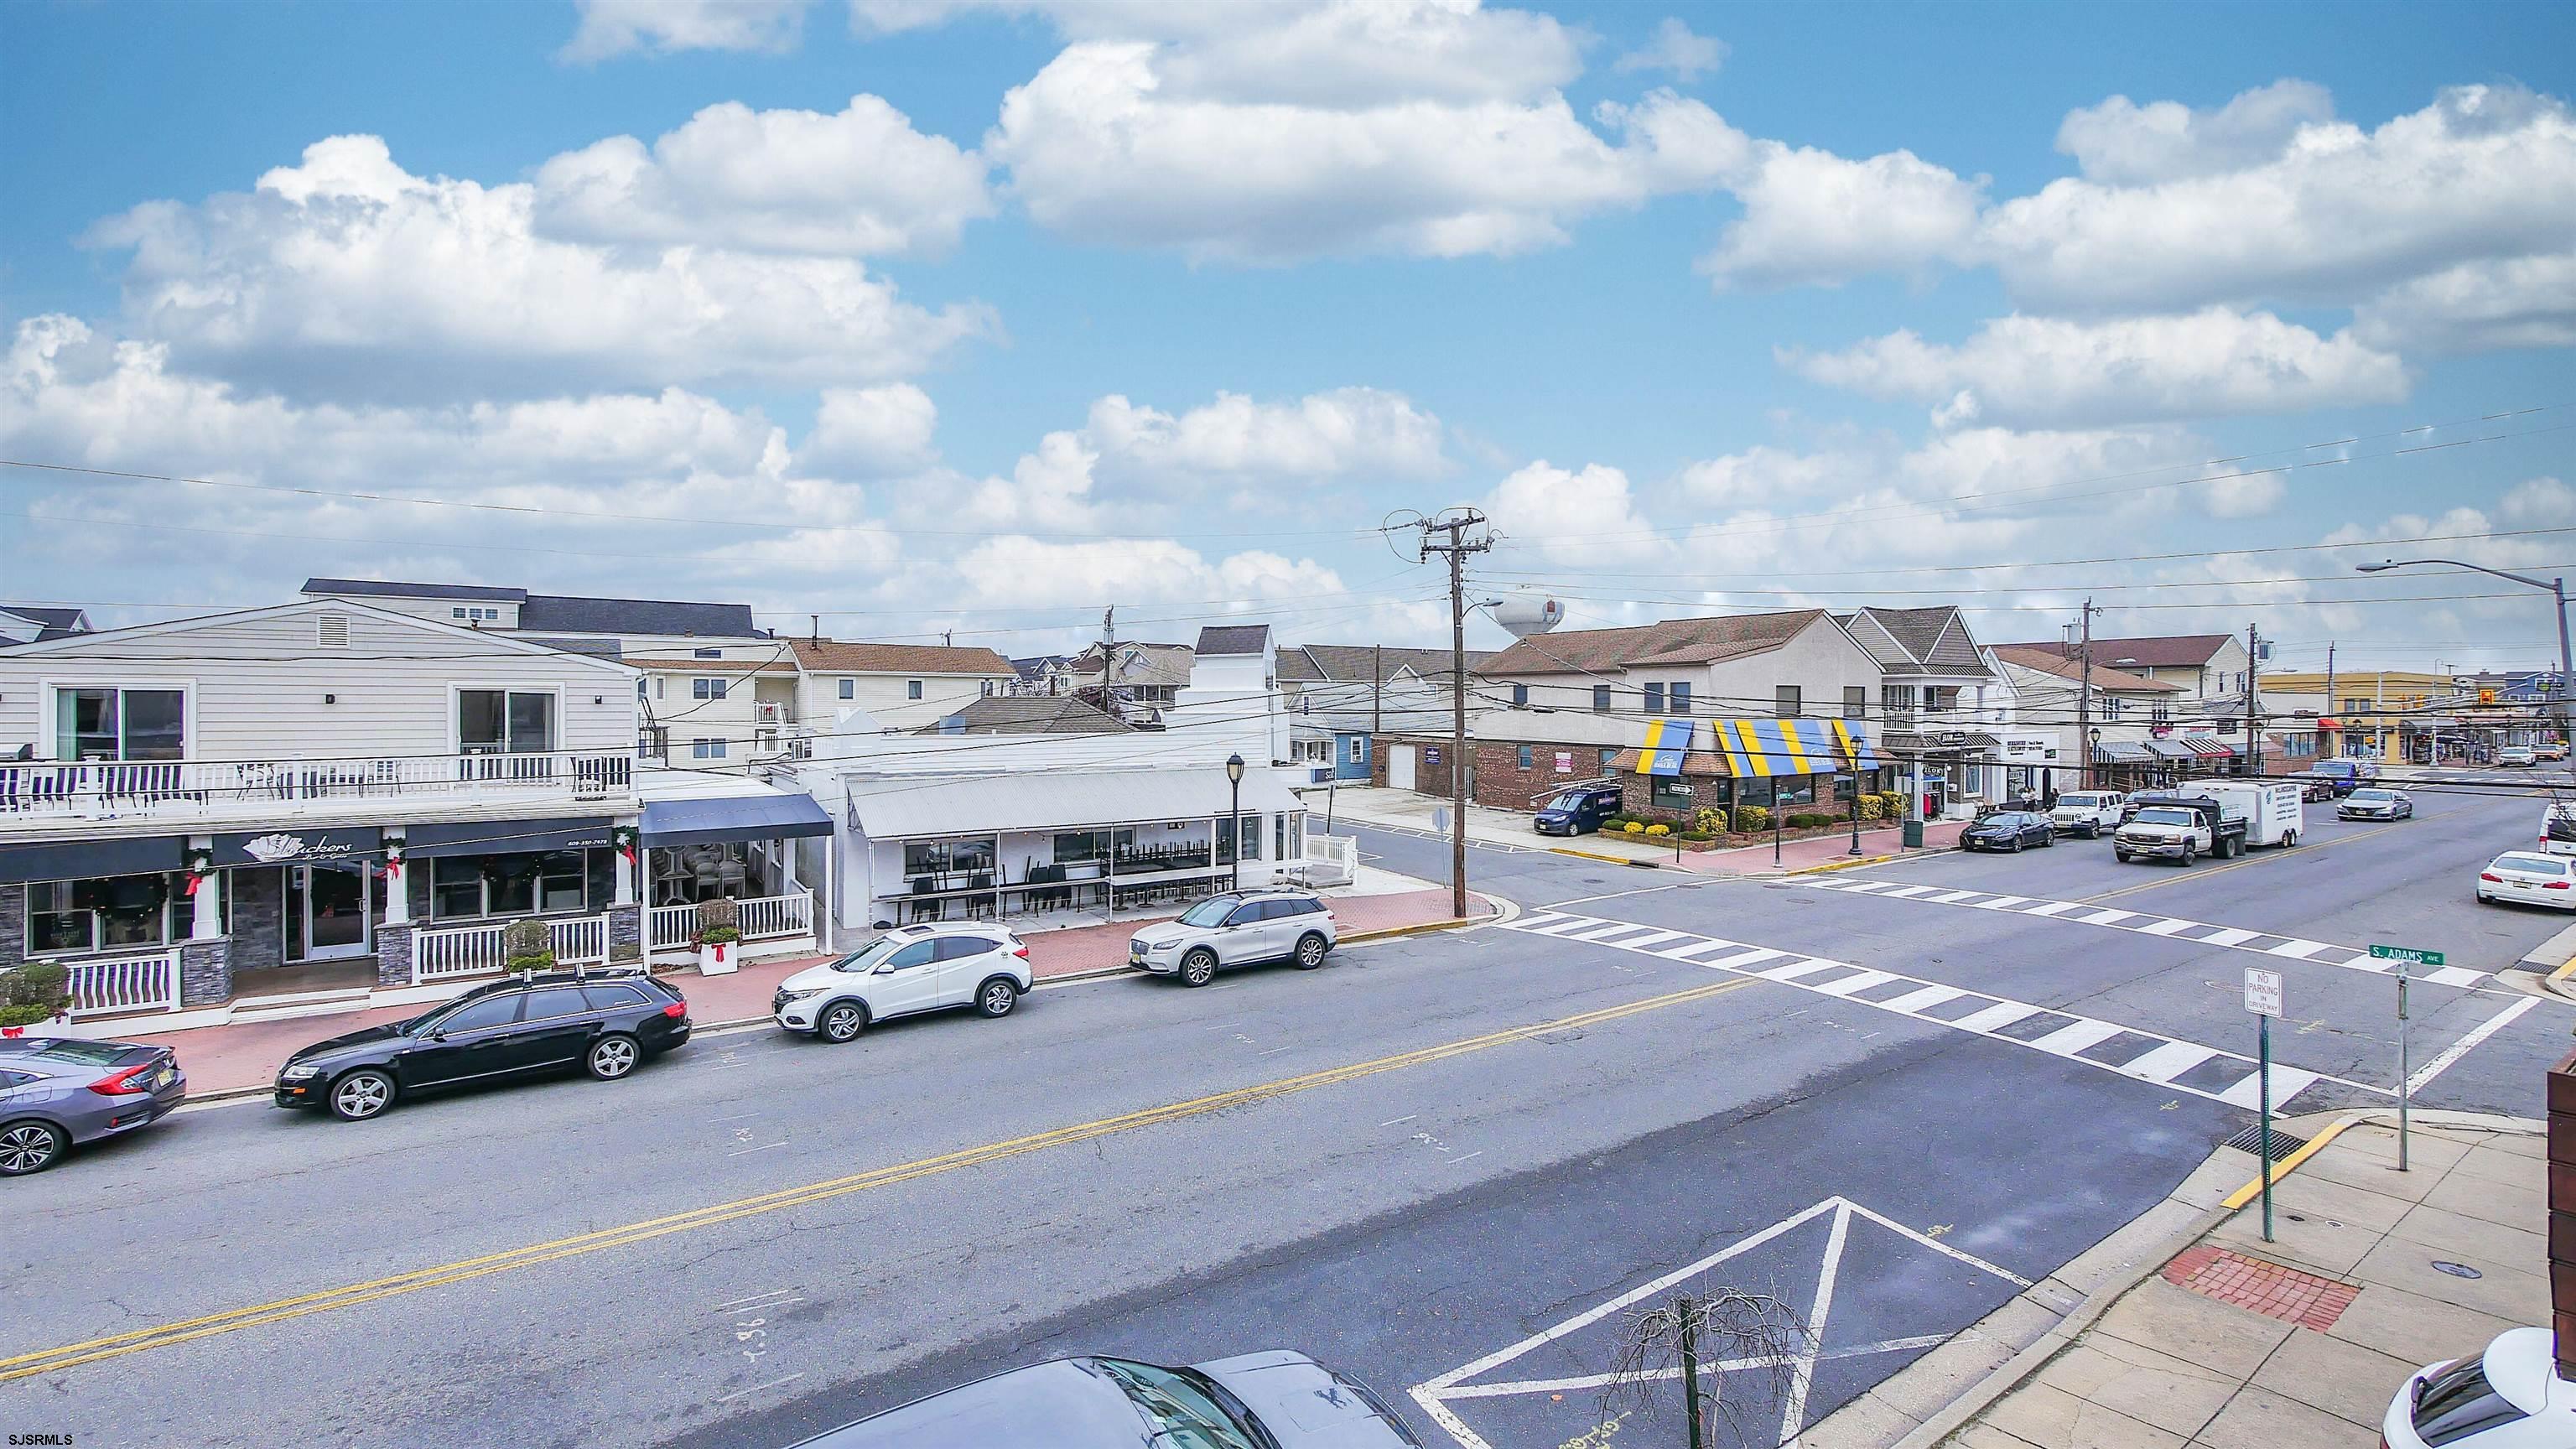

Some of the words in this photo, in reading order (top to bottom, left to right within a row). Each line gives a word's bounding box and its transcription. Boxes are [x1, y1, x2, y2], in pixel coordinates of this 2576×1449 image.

[2372, 946, 2383, 958] S.
[2387, 948, 2423, 962] ADAMS
[2257, 974, 2269, 984] NO
[2248, 982, 2278, 996] PARKING
[2248, 1000, 2277, 1012] DRIVEWAY
